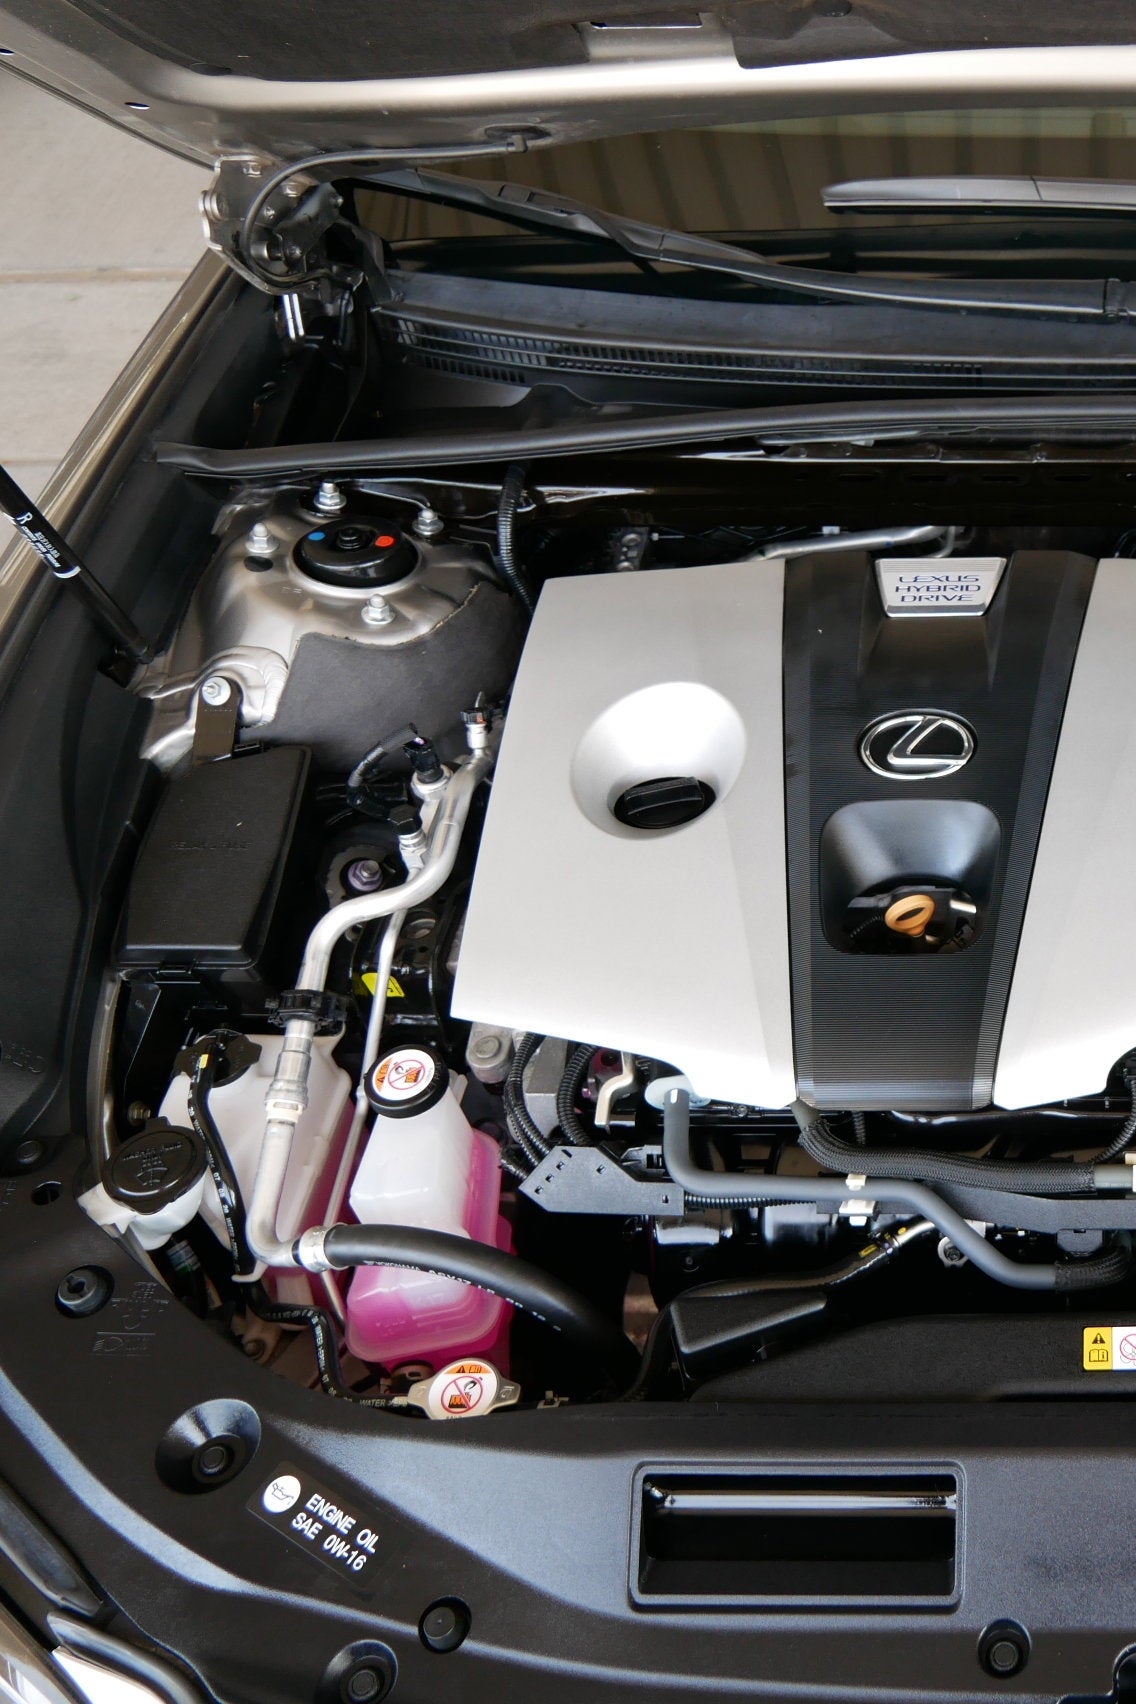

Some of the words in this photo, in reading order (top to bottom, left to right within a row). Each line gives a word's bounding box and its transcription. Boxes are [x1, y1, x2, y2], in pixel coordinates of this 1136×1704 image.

[16, 511, 33, 525] R
[898, 574, 980, 583] LEXUS
[895, 584, 981, 593] HYBRID
[901, 594, 975, 603] DRIVE
[360, 1399, 386, 1408] WATER
[304, 1493, 357, 1535] ENGINE
[356, 1528, 379, 1554] OIL
[291, 1512, 324, 1540] SAE
[322, 1534, 368, 1571] 0W-16
